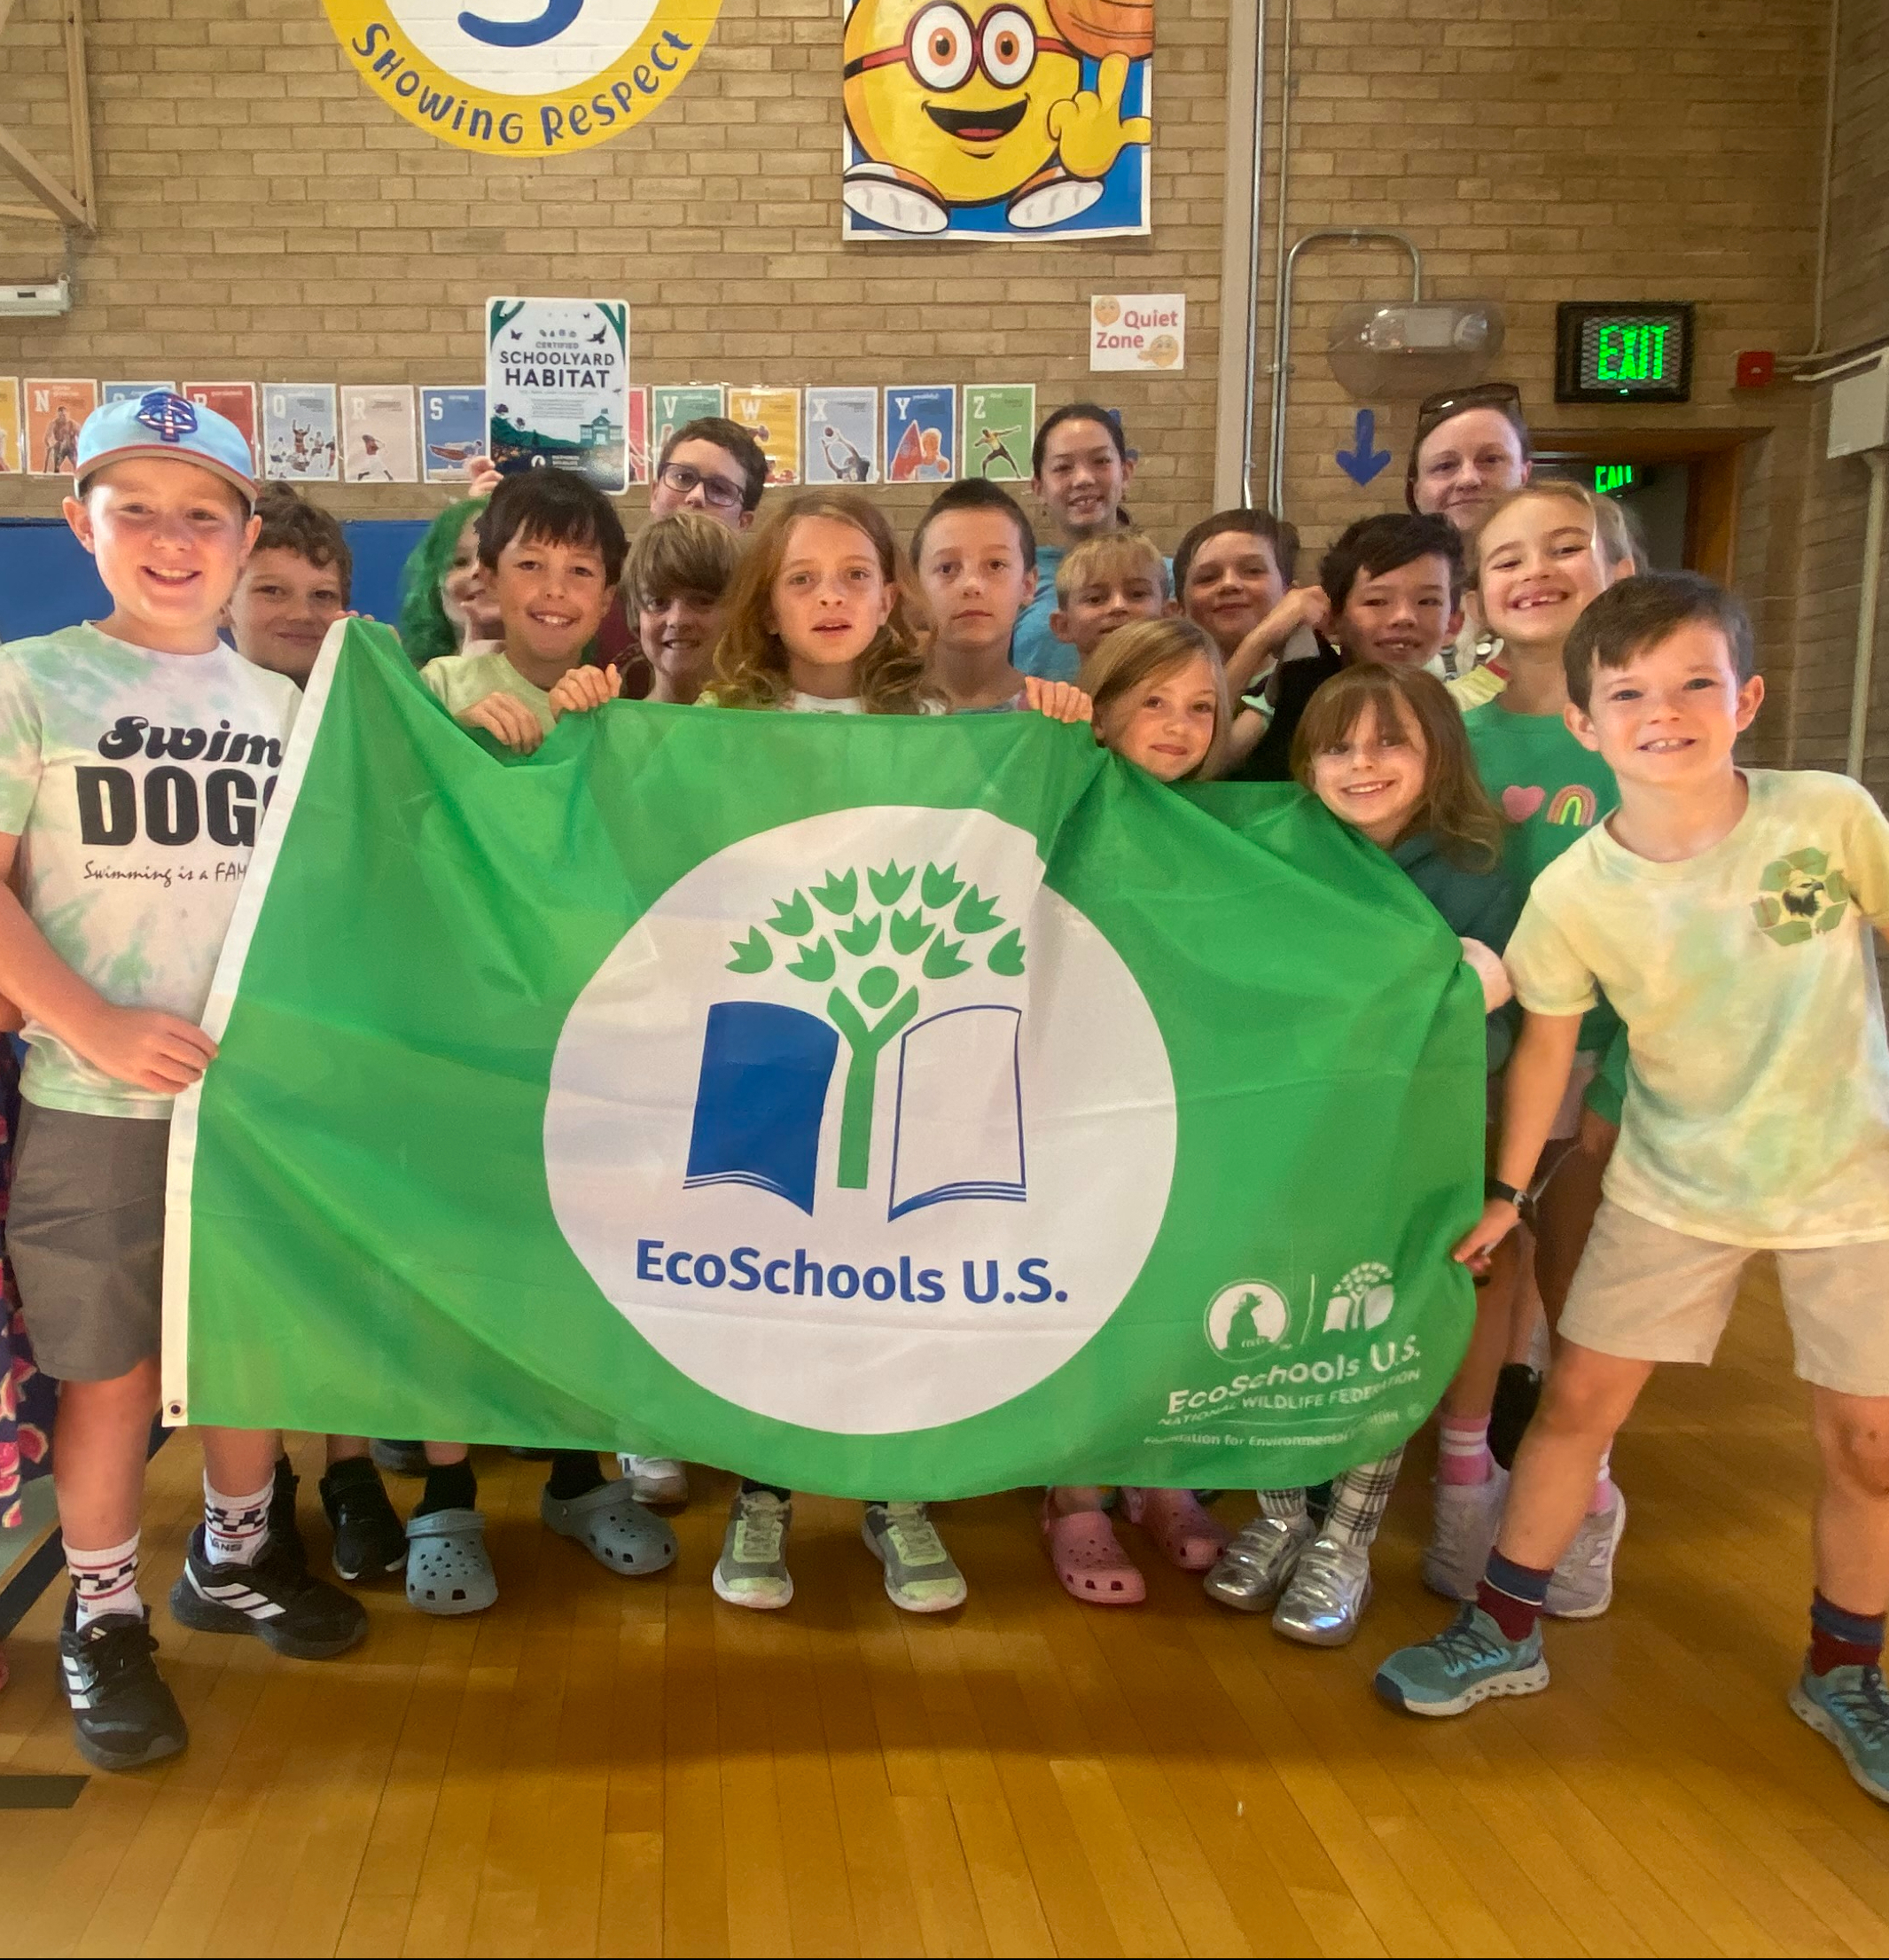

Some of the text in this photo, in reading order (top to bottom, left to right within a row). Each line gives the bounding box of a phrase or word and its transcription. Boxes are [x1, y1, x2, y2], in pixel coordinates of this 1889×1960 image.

[1124, 309, 1178, 330] Quiet
[1097, 332, 1144, 348] Zone
[499, 350, 615, 366] SCHOOLYARD
[1597, 324, 1669, 380] EXIT
[505, 368, 610, 388] HABITAT
[35, 390, 50, 412] N
[351, 397, 367, 420] R
[430, 397, 443, 420] S
[662, 396, 679, 419] V
[739, 399, 761, 421] W
[811, 398, 828, 422] X
[894, 397, 910, 420] Y
[973, 395, 986, 418] Z
[98, 715, 283, 768] Swim
[74, 765, 278, 847] DOG
[83, 860, 172, 887] Swimming
[178, 865, 193, 880] is
[199, 871, 209, 880] a
[636, 1238, 1068, 1304] EcoSchools U.S.
[1167, 1334, 1421, 1415] EcoSchools U.S.
[1243, 1394, 1325, 1409] WILDLIFE
[1224, 1433, 1245, 1445] for
